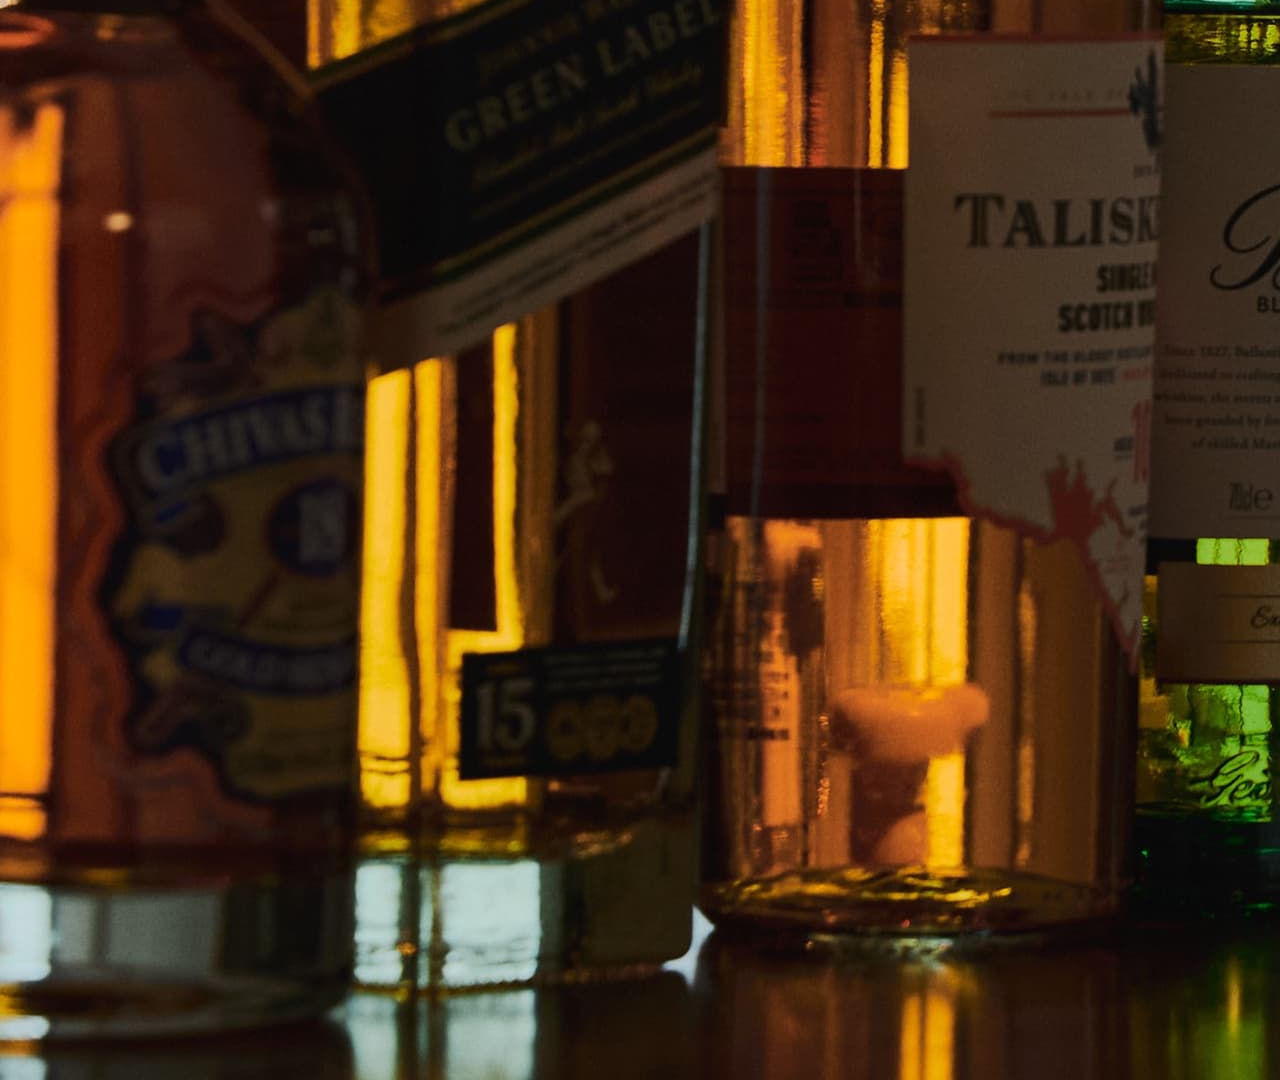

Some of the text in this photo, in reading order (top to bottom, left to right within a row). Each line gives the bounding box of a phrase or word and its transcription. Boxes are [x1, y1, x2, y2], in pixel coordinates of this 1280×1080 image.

[444, 53, 590, 154] GREEN
[1096, 262, 1153, 295] SINGLE
[1058, 299, 1134, 334] SCOTCH
[475, 677, 537, 752] 15
